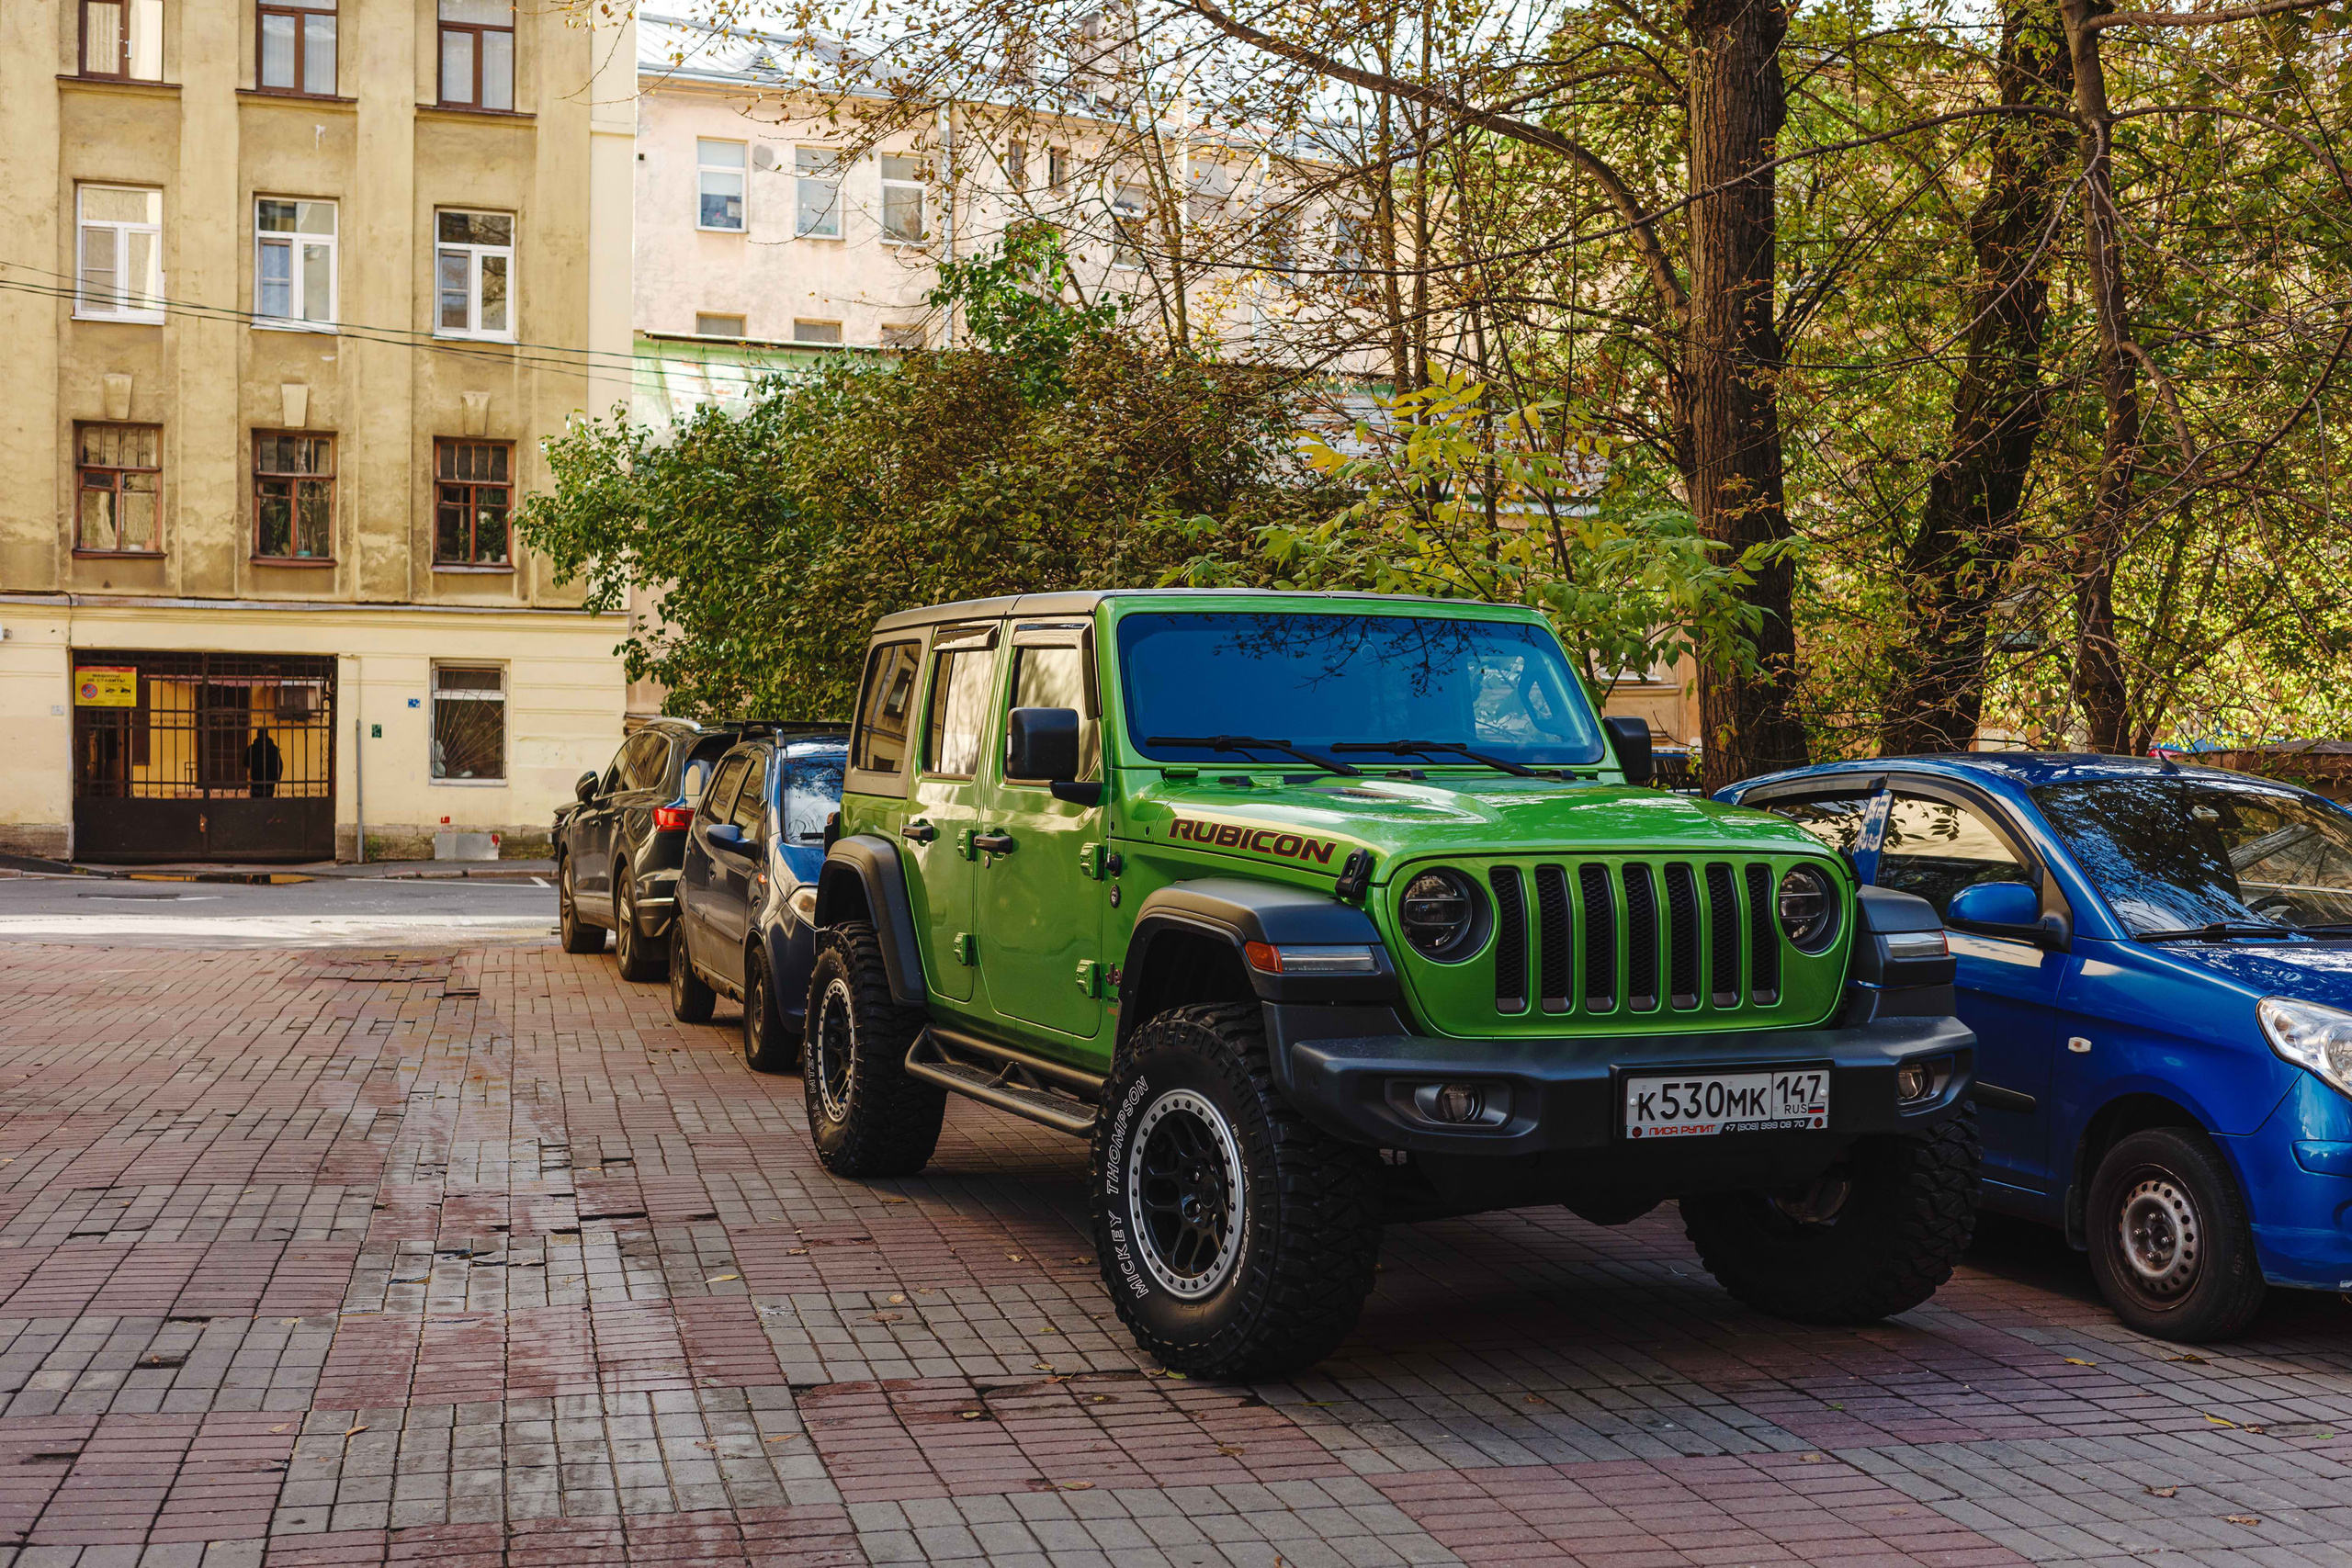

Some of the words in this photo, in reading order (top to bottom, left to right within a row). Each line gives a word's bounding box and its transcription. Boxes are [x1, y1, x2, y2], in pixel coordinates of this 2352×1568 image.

[1168, 818, 1338, 865] RUBICON
[1105, 962, 1122, 987] Je
[1637, 1080, 1767, 1122] К530МК
[1776, 1075, 1822, 1104] 147
[1784, 1103, 1807, 1114] RUS
[1106, 1075, 1149, 1195] THOMPSON
[1793, 1119, 1805, 1128] 70
[1107, 1210, 1149, 1299] MICKEY
